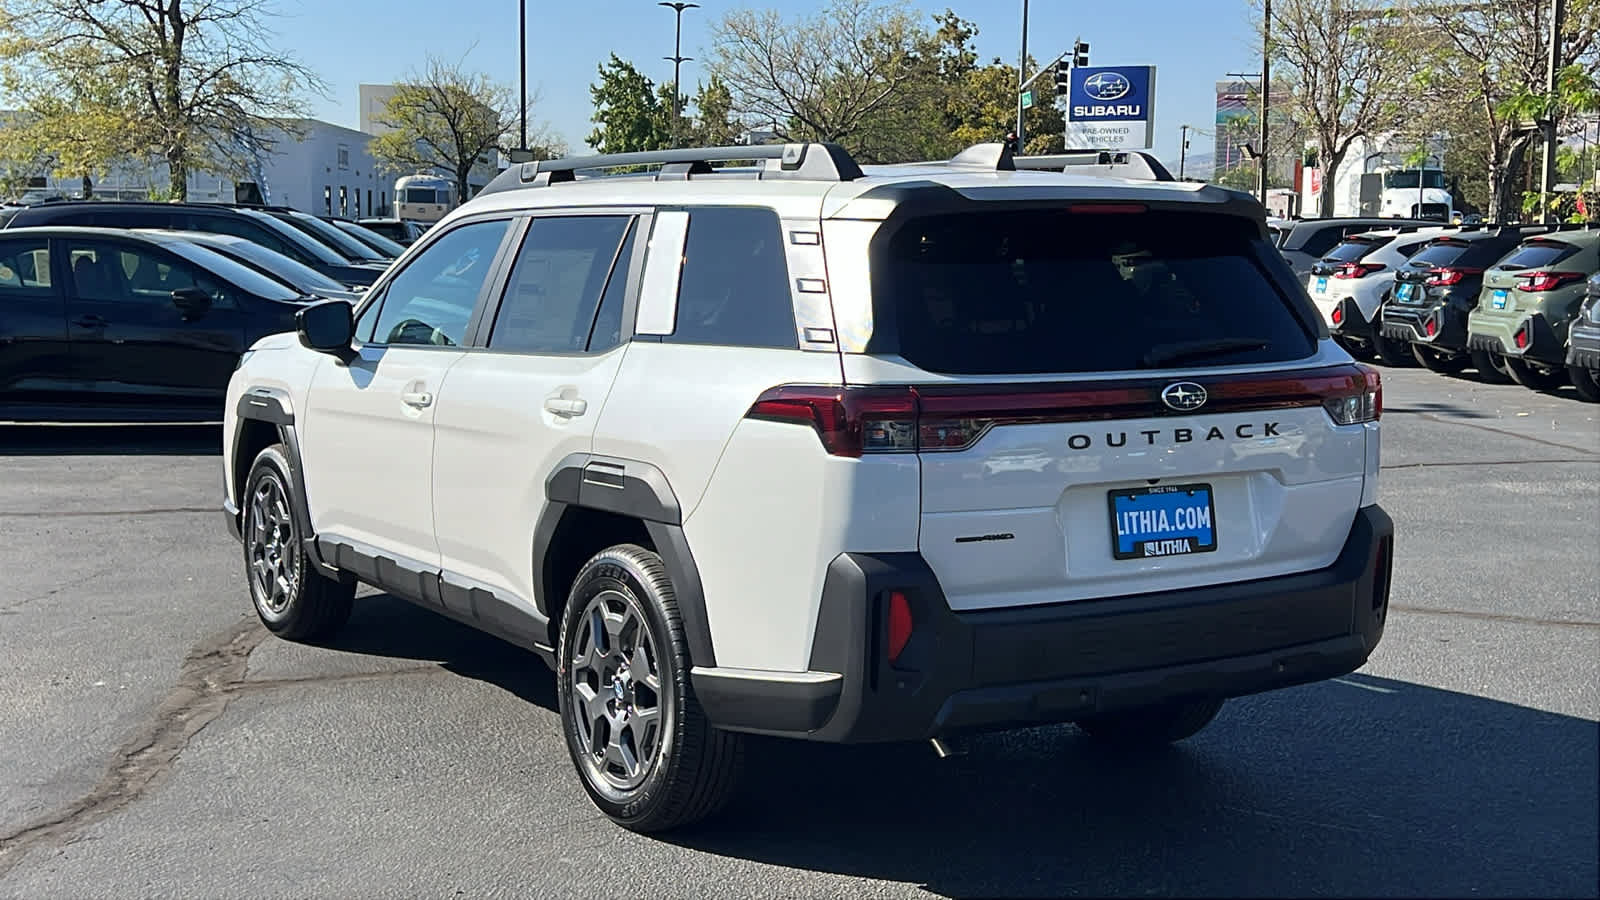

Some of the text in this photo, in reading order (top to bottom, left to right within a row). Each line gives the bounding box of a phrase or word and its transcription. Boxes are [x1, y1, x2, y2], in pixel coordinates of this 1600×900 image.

[1074, 105, 1140, 116] SUBARU
[1082, 127, 1129, 135] PRE-OWNED
[1087, 135, 1124, 143] VEHICLES
[1067, 421, 1280, 449] OUTBACK
[1116, 506, 1211, 536] LITHIA.COM
[1156, 539, 1191, 554] LITHIA
